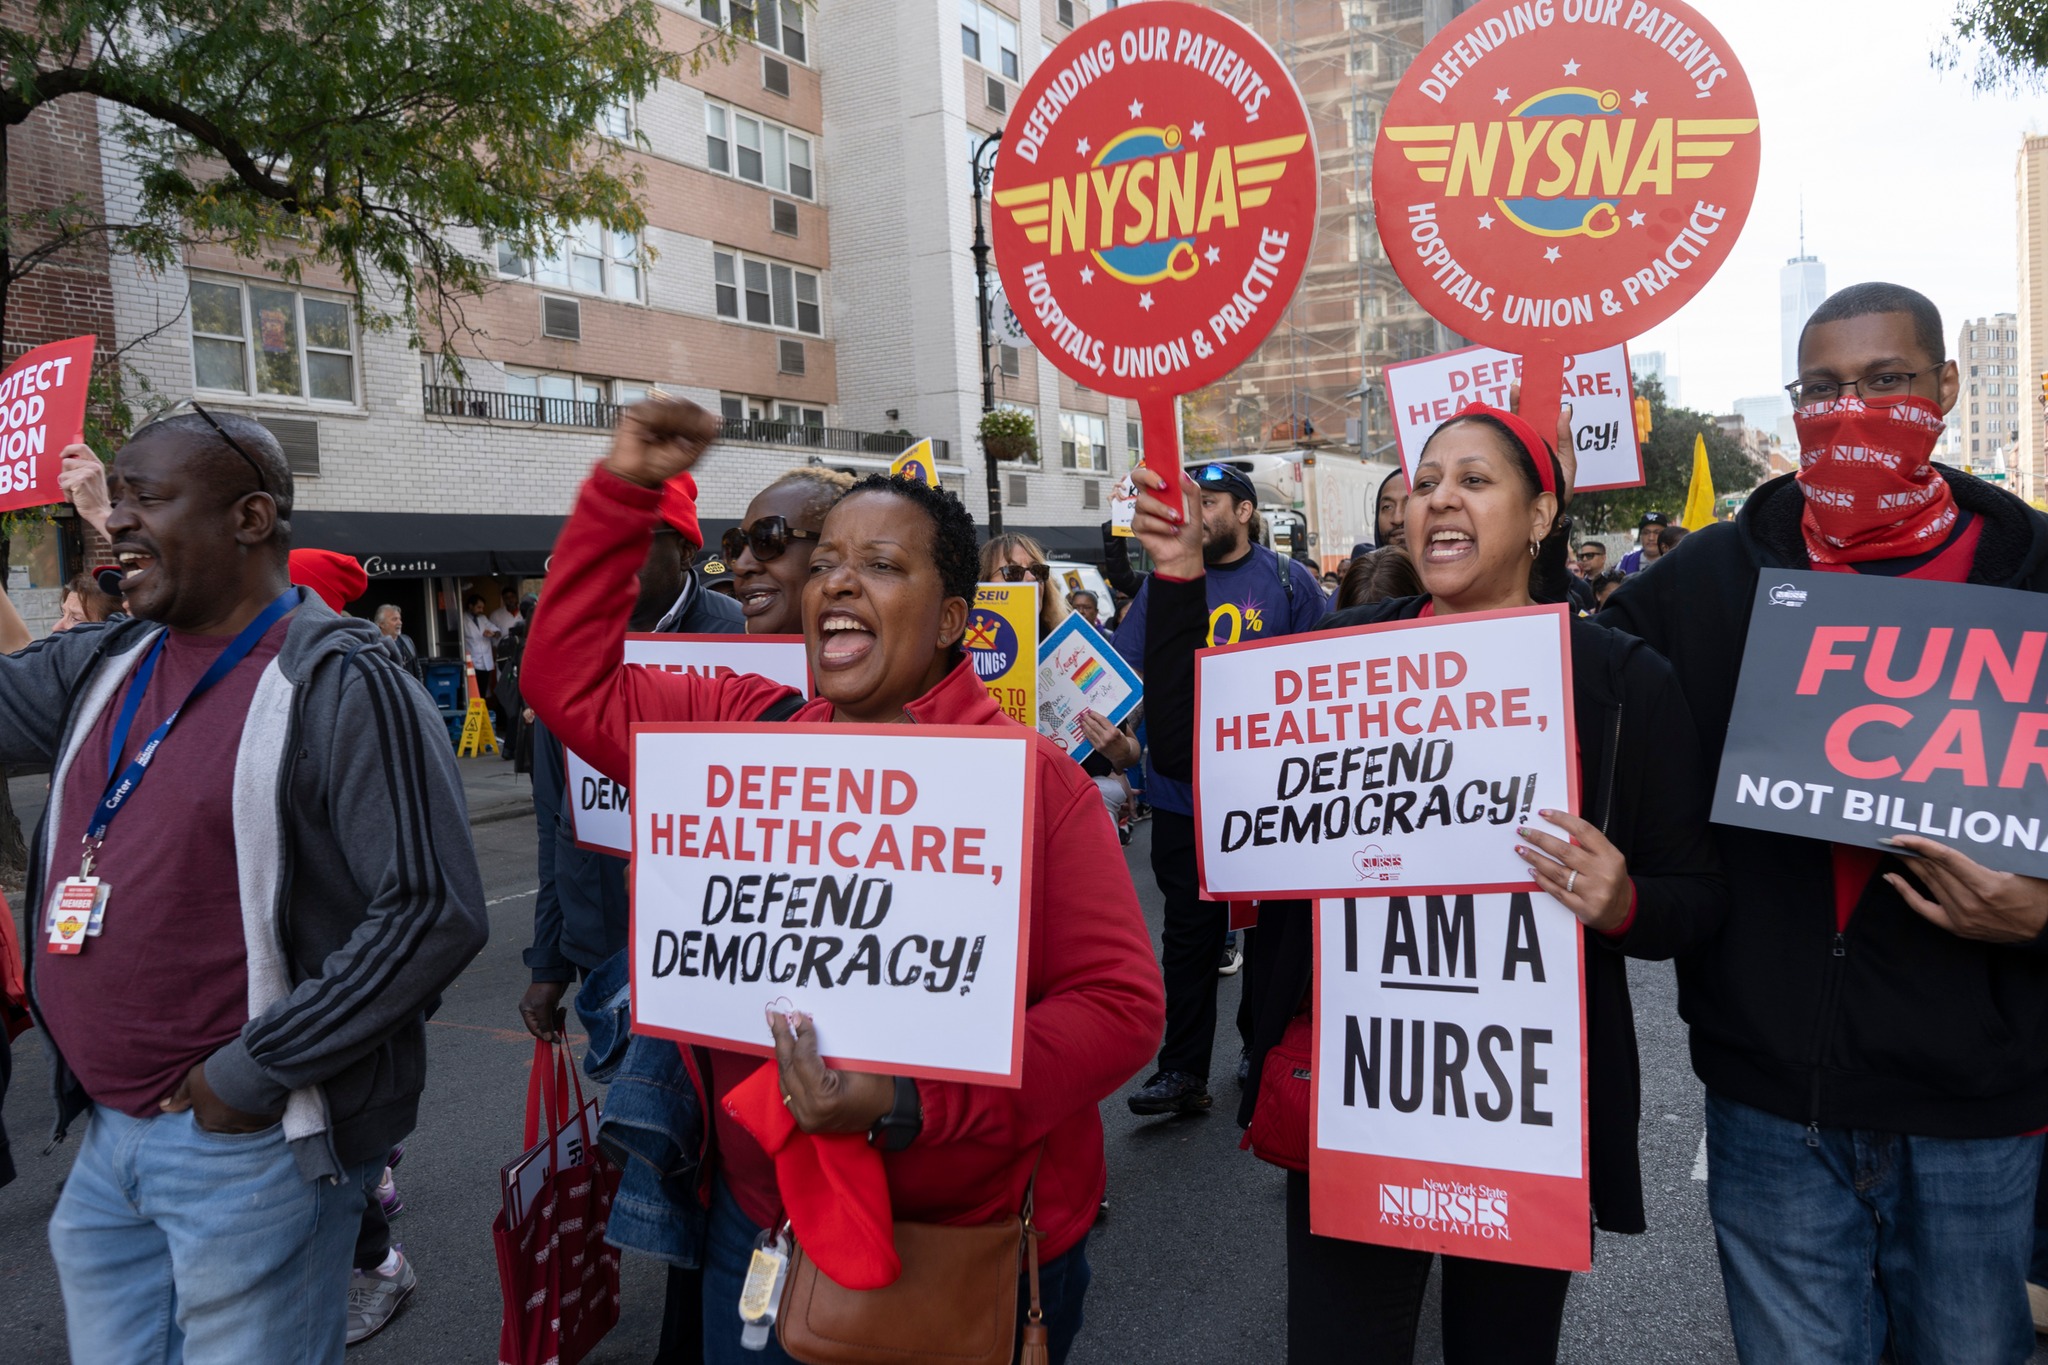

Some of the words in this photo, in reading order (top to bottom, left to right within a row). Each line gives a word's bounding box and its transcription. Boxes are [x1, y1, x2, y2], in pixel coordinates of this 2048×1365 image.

[1418, 0, 1554, 104] DEFENDING
[1563, 0, 1618, 26] OUR
[1623, 1, 1727, 99] PATIENTS,
[1016, 39, 1115, 165] DEFENDING
[1120, 27, 1170, 64] OUR
[1174, 29, 1271, 123] PATIENTS,
[1444, 118, 1673, 197] NYSNA
[1049, 145, 1240, 256] NYSNA
[1407, 203, 1496, 322] HOSPITALS,
[1502, 294, 1594, 327] UNION
[1600, 288, 1624, 317] &
[1622, 200, 1727, 305] PRACTICE
[1022, 262, 1106, 377] HOSPITALS,
[1113, 337, 1190, 378] UNION
[1193, 329, 1214, 360] &
[1208, 227, 1289, 346] PRACTICE
[0, 357, 72, 405] OTECT
[1449, 355, 1575, 393] DEFED
[1798, 482, 1855, 507] URSES
[364, 556, 436, 576] Citarella
[976, 590, 1009, 601] SEIU
[973, 651, 1007, 675] KINGS
[1274, 650, 1468, 706] DEFEND
[1795, 626, 2048, 704] FUN
[1007, 688, 1026, 706] TO
[1215, 687, 1548, 752] HEALTHCARE,
[106, 778, 132, 810] Carter
[706, 764, 918, 816] DEFEND
[1277, 737, 1453, 801] DEFEND
[1736, 774, 1834, 815] NOT
[1220, 772, 1538, 854] DEMOCRACY!
[651, 813, 1003, 886] HEALTHCARE,
[701, 872, 893, 930] DEFEND
[652, 928, 986, 997] DEMOCRACY!
[1343, 897, 1358, 973] I
[1381, 893, 1477, 979] AM
[1502, 892, 1546, 983] A
[1343, 1014, 1554, 1127] NURSE
[1380, 1184, 1508, 1227] NURSES
[1423, 1178, 1449, 1193] New
[1451, 1180, 1477, 1196] York
[1478, 1185, 1508, 1199] State
[1380, 1212, 1510, 1241] ASSOCIATION
